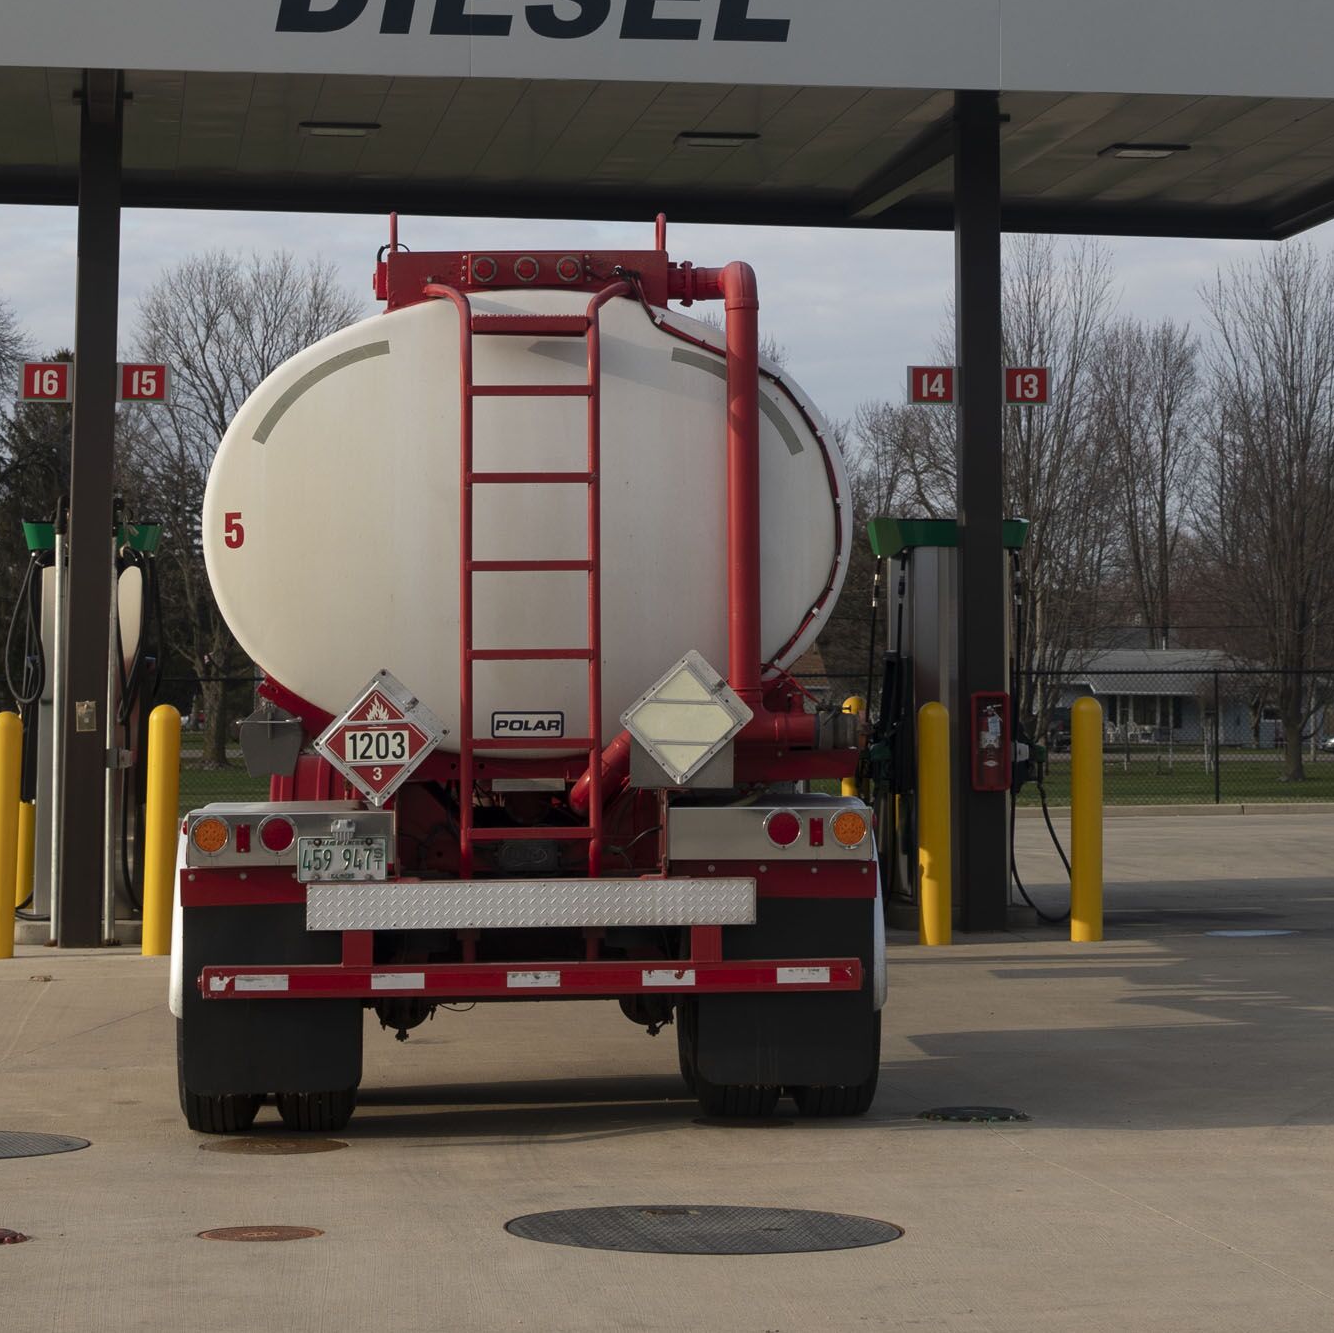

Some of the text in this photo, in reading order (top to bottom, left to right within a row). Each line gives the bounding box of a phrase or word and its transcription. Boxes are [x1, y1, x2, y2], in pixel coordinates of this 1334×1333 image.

[33, 370, 58, 395] 16
[132, 370, 157, 396] 15
[922, 373, 945, 398] 14
[1015, 374, 1038, 399] 13
[224, 511, 244, 549] 5
[495, 720, 560, 731] POLAR
[348, 732, 406, 760] 1203
[373, 766, 382, 781] 3
[302, 848, 371, 871] 459 947
